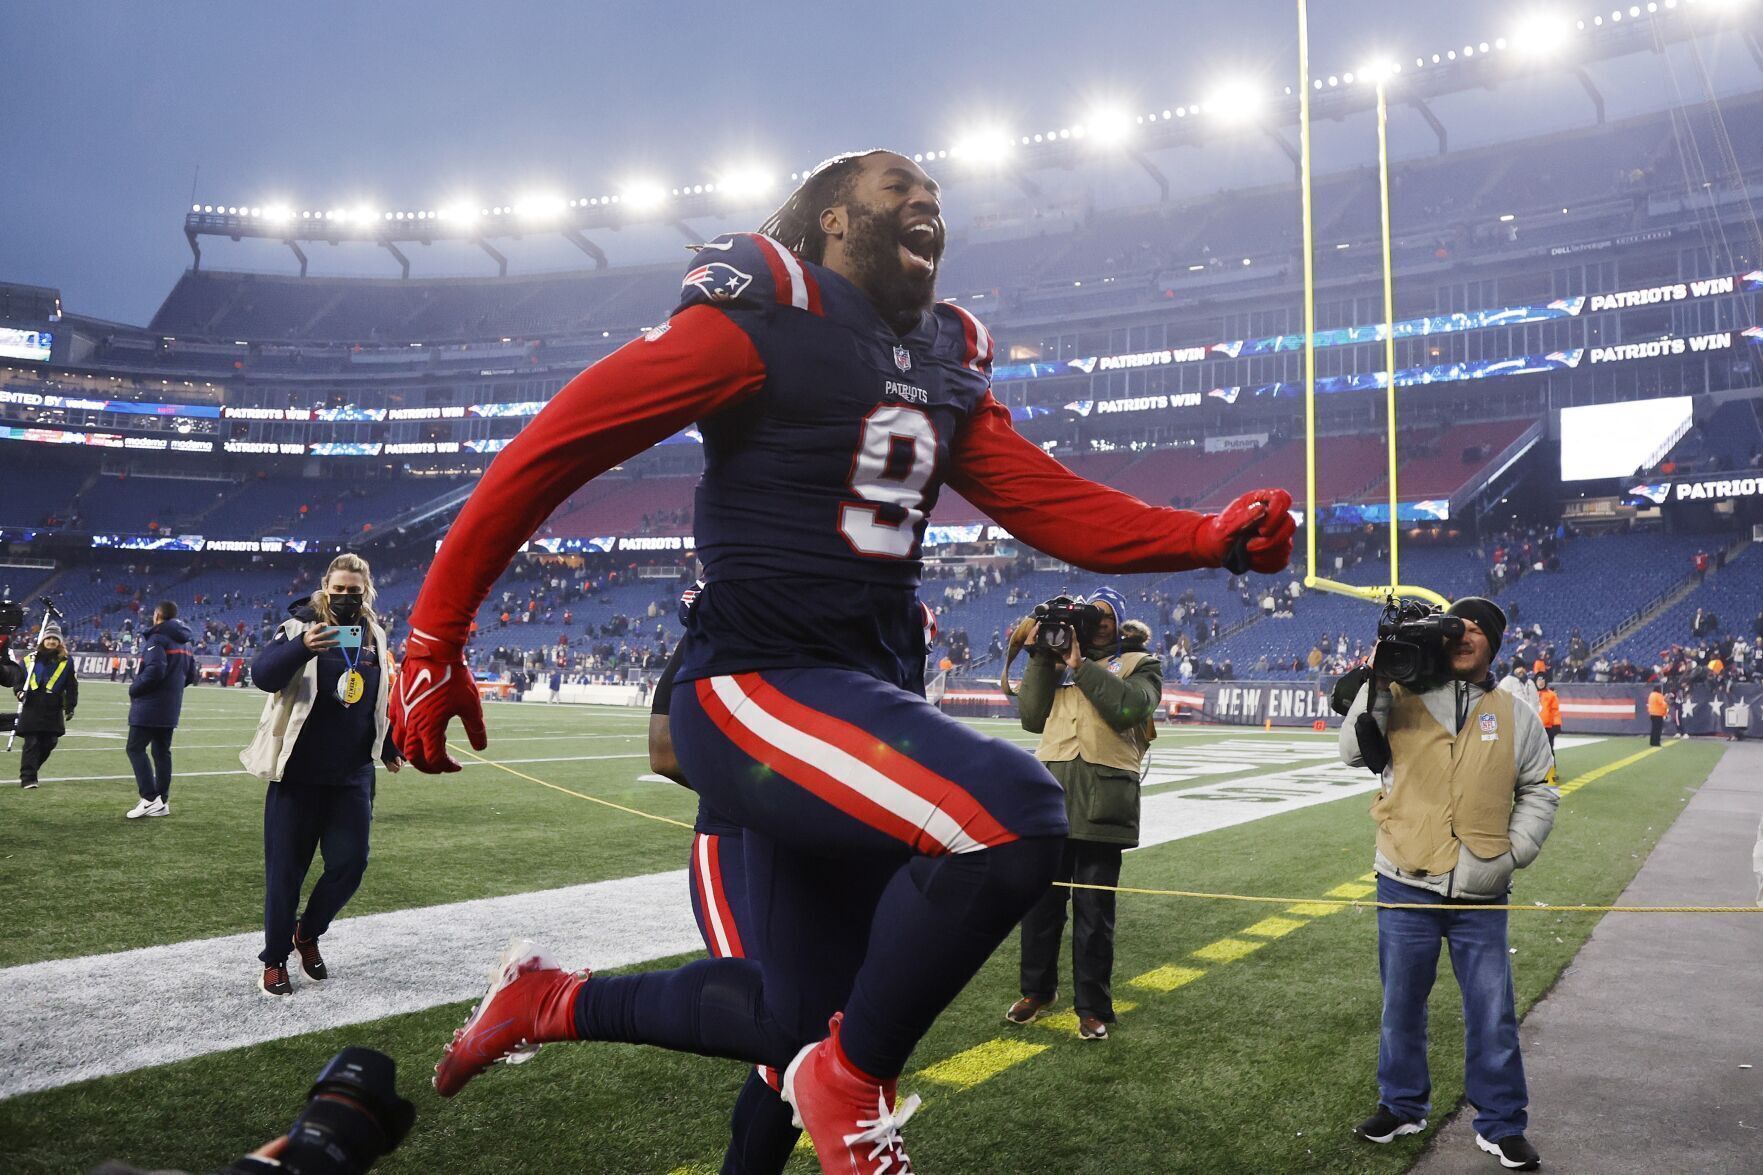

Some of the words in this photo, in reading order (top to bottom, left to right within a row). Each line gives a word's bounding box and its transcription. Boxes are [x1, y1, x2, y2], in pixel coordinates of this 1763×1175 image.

[1590, 283, 1687, 311] PATRIOTS
[1690, 276, 1734, 297] WIN
[1590, 338, 1685, 363] PATRIOTS
[1689, 333, 1731, 351] WIN
[1100, 350, 1171, 370] PATRIOTS
[1173, 347, 1205, 363] WIN
[44, 395, 63, 406] BY
[885, 380, 928, 404] PATRIOTS
[1097, 396, 1168, 414] PATRIOTS
[1170, 392, 1201, 408] WIN
[225, 408, 284, 420] PATRIOTS
[285, 409, 310, 420] WIN
[388, 408, 441, 420] PATRIOTS
[441, 407, 464, 418] WIN
[280, 443, 305, 454] WIN
[385, 443, 436, 454] PATRIOTS
[437, 442, 459, 453] WIN
[837, 402, 938, 559] 9
[206, 541, 260, 552] PATRIOTS
[261, 541, 282, 552] WIN
[619, 537, 681, 550] PATRIOTS
[1216, 688, 1261, 716] NEW
